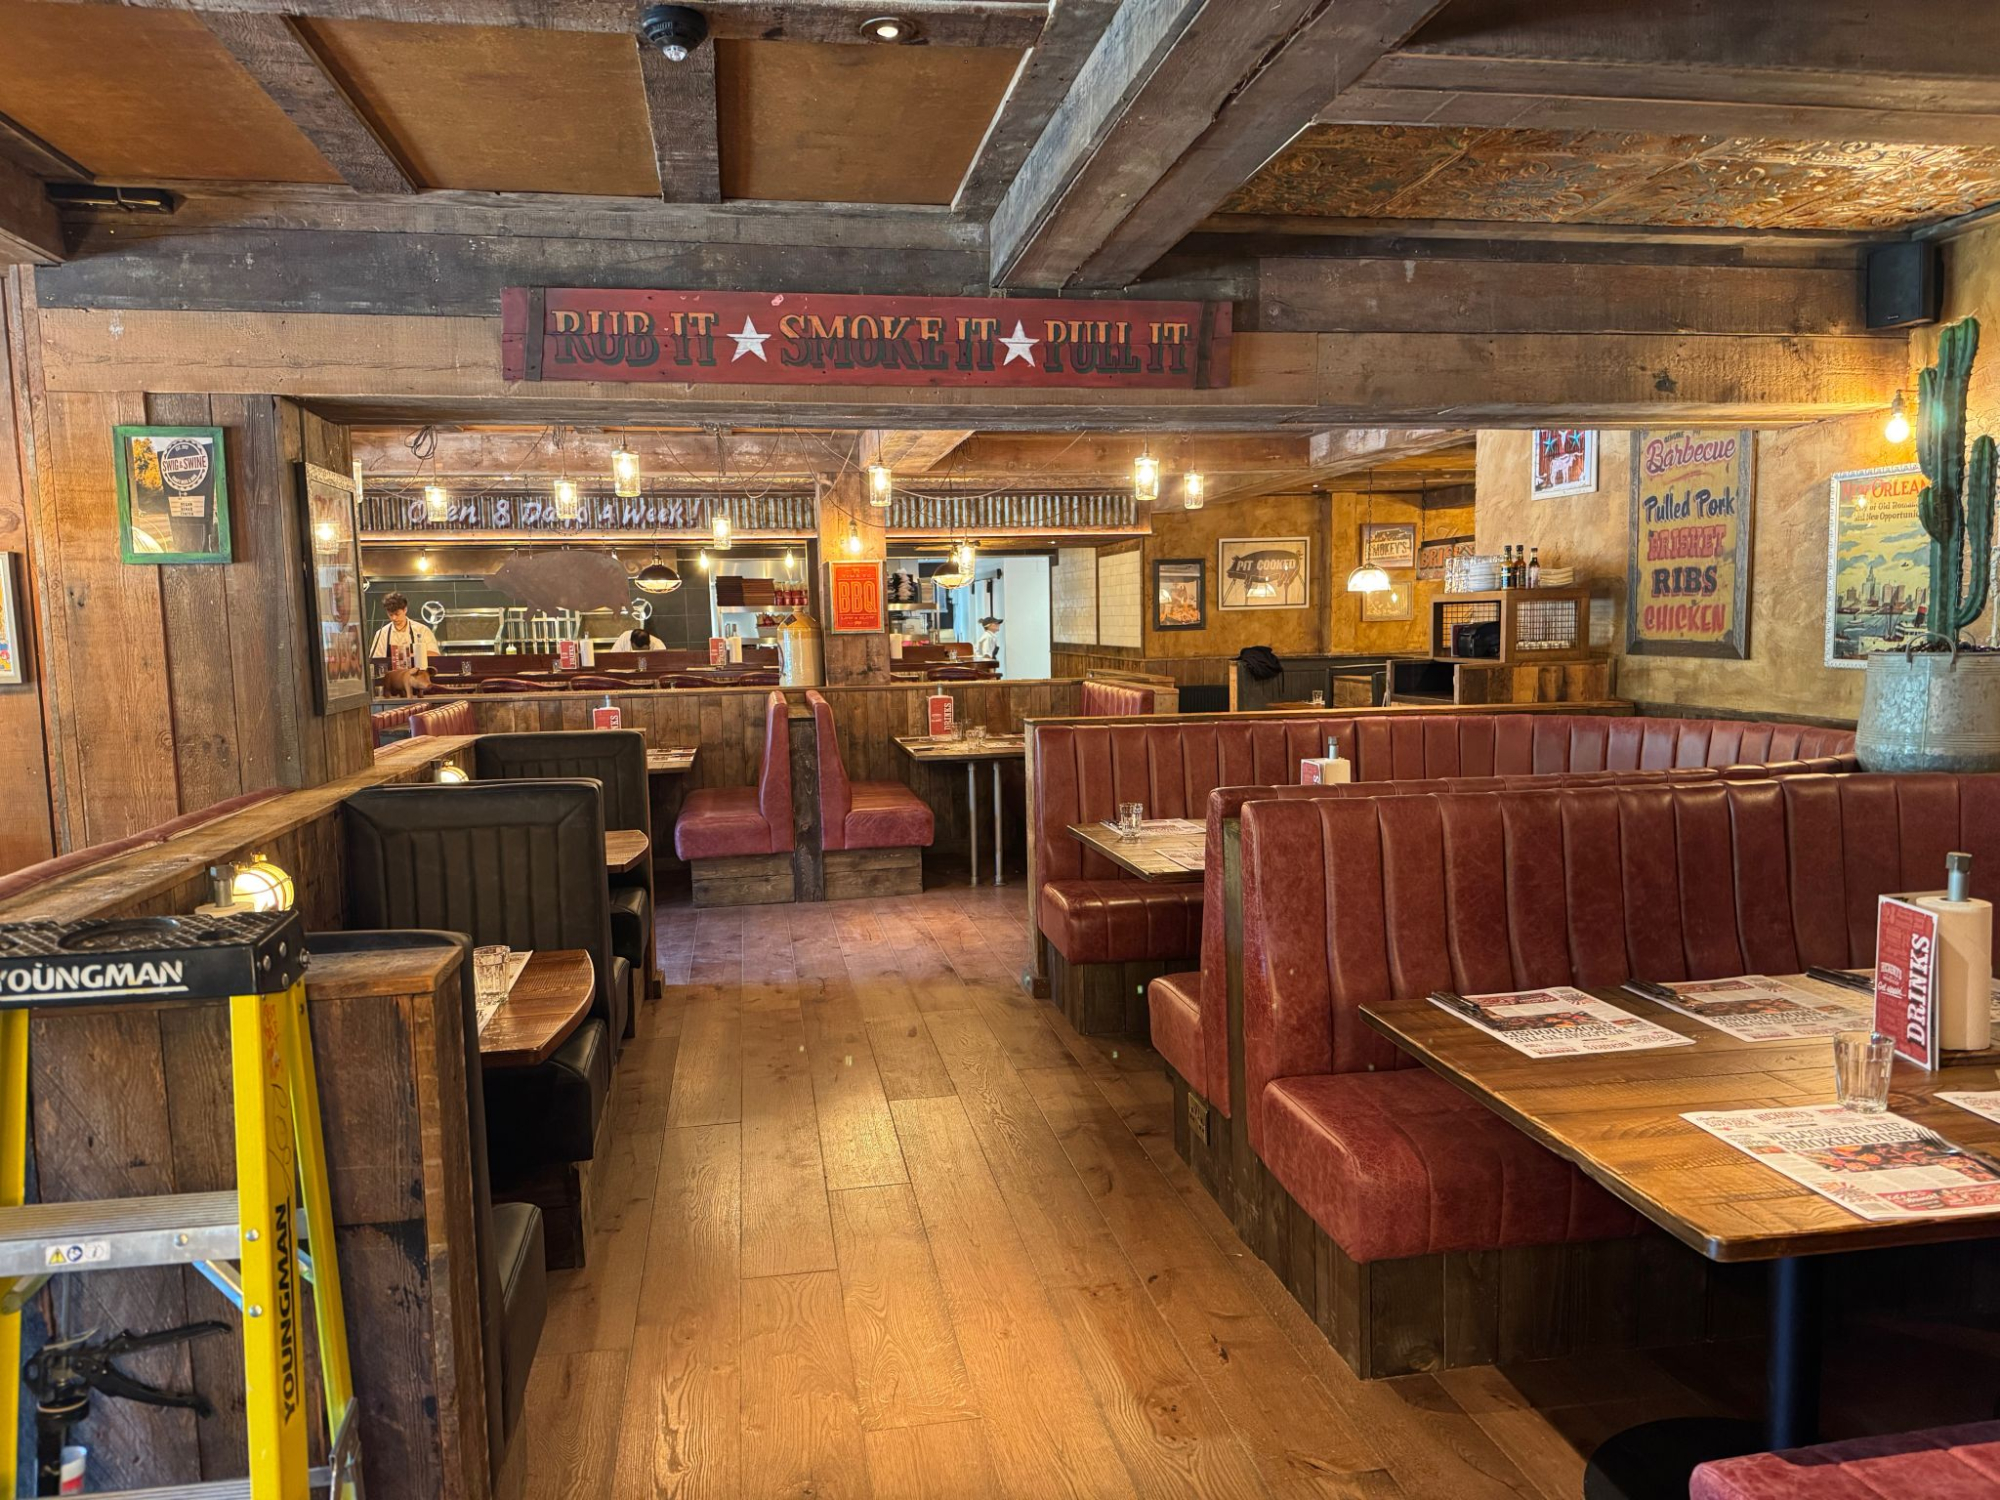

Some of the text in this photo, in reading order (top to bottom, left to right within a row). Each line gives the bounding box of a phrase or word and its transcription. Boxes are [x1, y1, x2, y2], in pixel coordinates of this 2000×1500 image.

[552, 311, 1195, 374] RUB IT SMOKE IT PULL IT
[163, 459, 179, 471] SWIG
[184, 456, 206, 469] SWINE
[1645, 435, 1736, 476] Barbecue
[1872, 477, 1928, 498] ORLEA
[408, 500, 478, 524] Oen
[494, 499, 510, 526] 8
[1644, 486, 1735, 523] Pulled Pork
[1878, 502, 1890, 510] Old
[1880, 510, 1919, 522] Opportuni
[1647, 524, 1727, 561] BRISKET
[1236, 559, 1297, 571] PIT COOKED
[838, 581, 877, 613] BBQ
[1651, 566, 1718, 597] RIBS
[1644, 603, 1727, 634] CHICKEN
[1907, 933, 1930, 1047] DRINKS
[1761, 1126, 1848, 1141] WELCOME
[1846, 1124, 1869, 1134] TO
[1868, 1122, 1909, 1131] THE
[275, 1203, 295, 1426] YOUNGMAN
